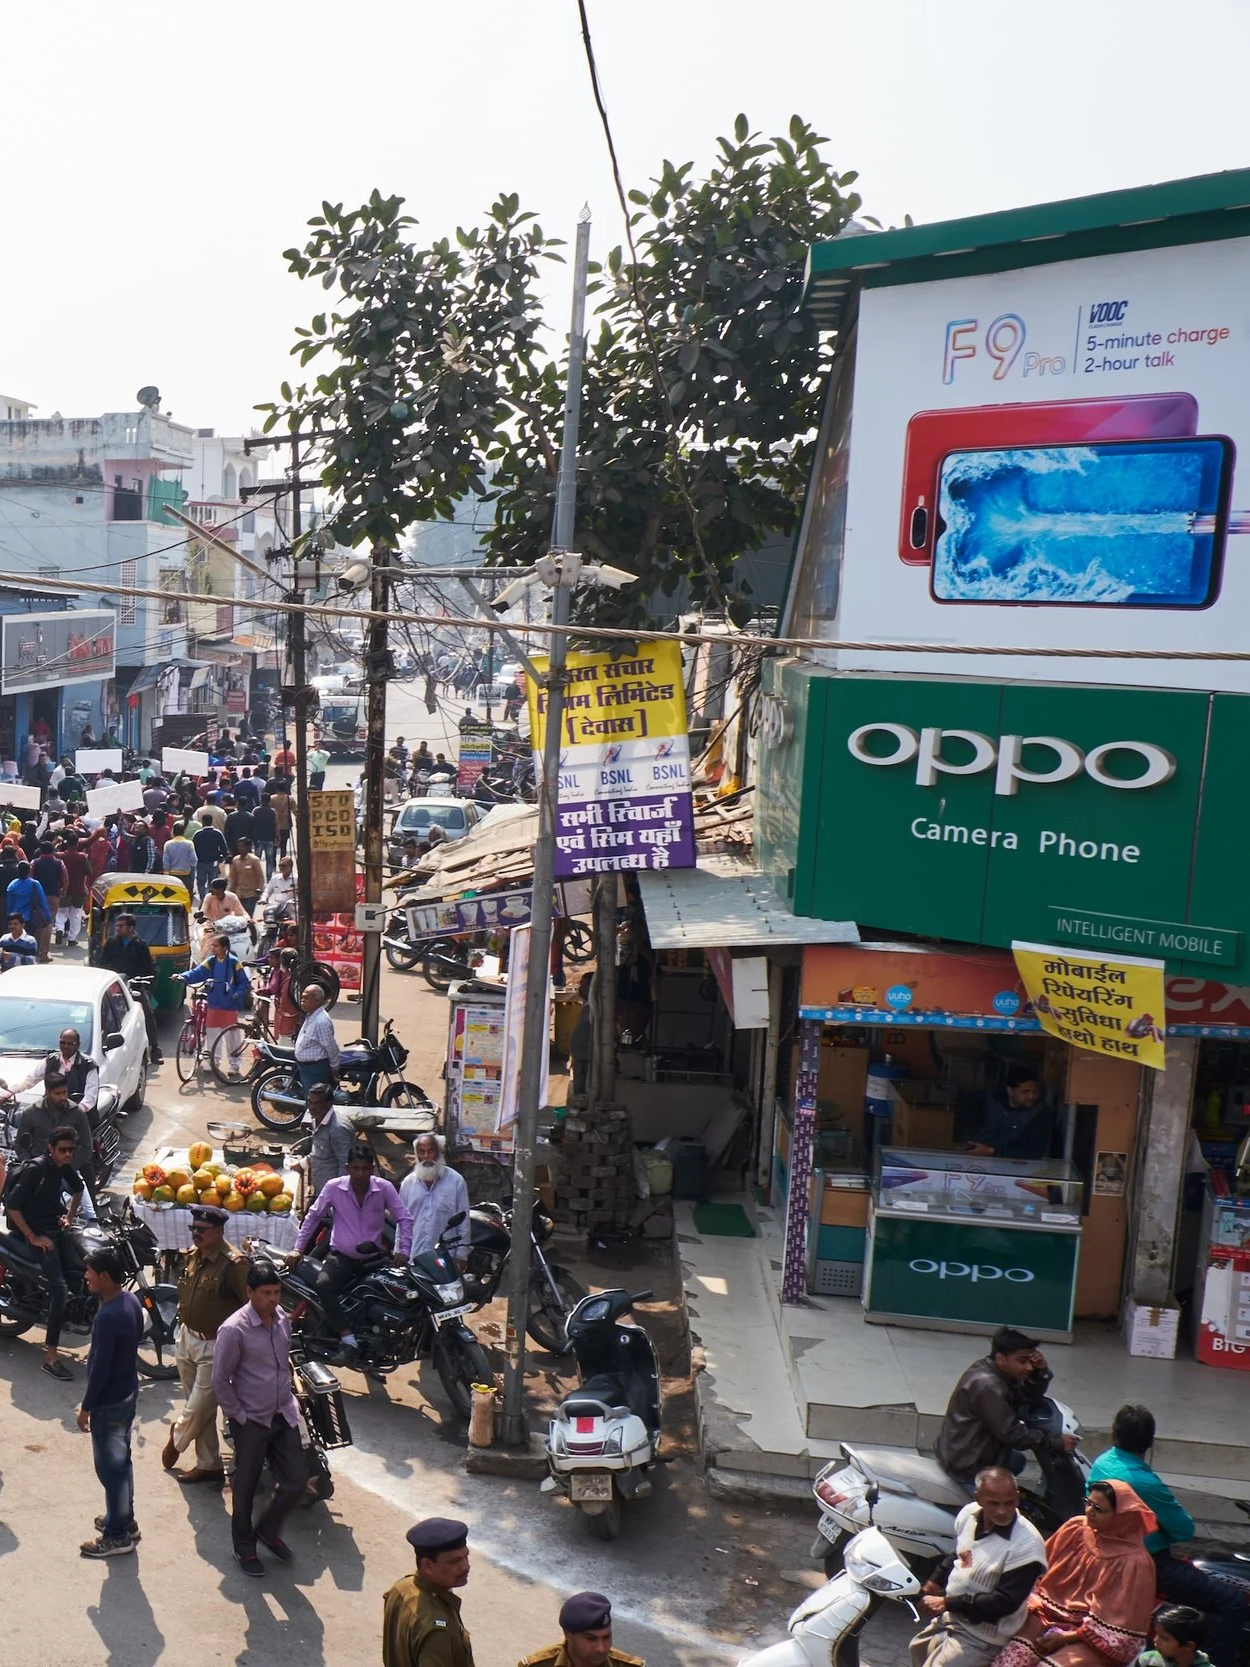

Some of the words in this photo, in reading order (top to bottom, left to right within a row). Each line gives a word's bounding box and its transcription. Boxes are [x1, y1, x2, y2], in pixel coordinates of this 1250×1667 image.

[942, 312, 1027, 386] F9
[1022, 351, 1067, 378] Pro
[1086, 331, 1162, 352] 5-minute
[1166, 325, 1230, 346] charge
[1084, 354, 1140, 373] 2-hour
[1145, 350, 1175, 369] talk
[596, 681, 675, 708] लिमिटेड
[652, 763, 686, 781] BSNL
[847, 721, 1178, 797] oppo
[558, 774, 581, 790] SNL
[601, 768, 633, 786] BSNL
[559, 803, 603, 827] सभी
[607, 796, 679, 823] रिचार्ज
[556, 828, 586, 854] एवं
[590, 826, 635, 849] सिम
[639, 820, 683, 846] यहाँ
[910, 816, 1019, 851] Camera
[1038, 831, 1141, 864] Phone
[571, 853, 648, 874] उपलब्ध
[651, 846, 670, 871] है
[1056, 917, 1156, 945] INTELLIGENT
[1158, 932, 1223, 956] MOBILE
[1043, 957, 1126, 985] मोबाईल
[1041, 978, 1134, 1010] रिपेयरिंग
[1059, 1006, 1123, 1031] सुविधा
[1099, 1035, 1140, 1058] हाथ
[909, 1258, 1036, 1283] oppo
[1212, 1336, 1247, 1354] BIG
